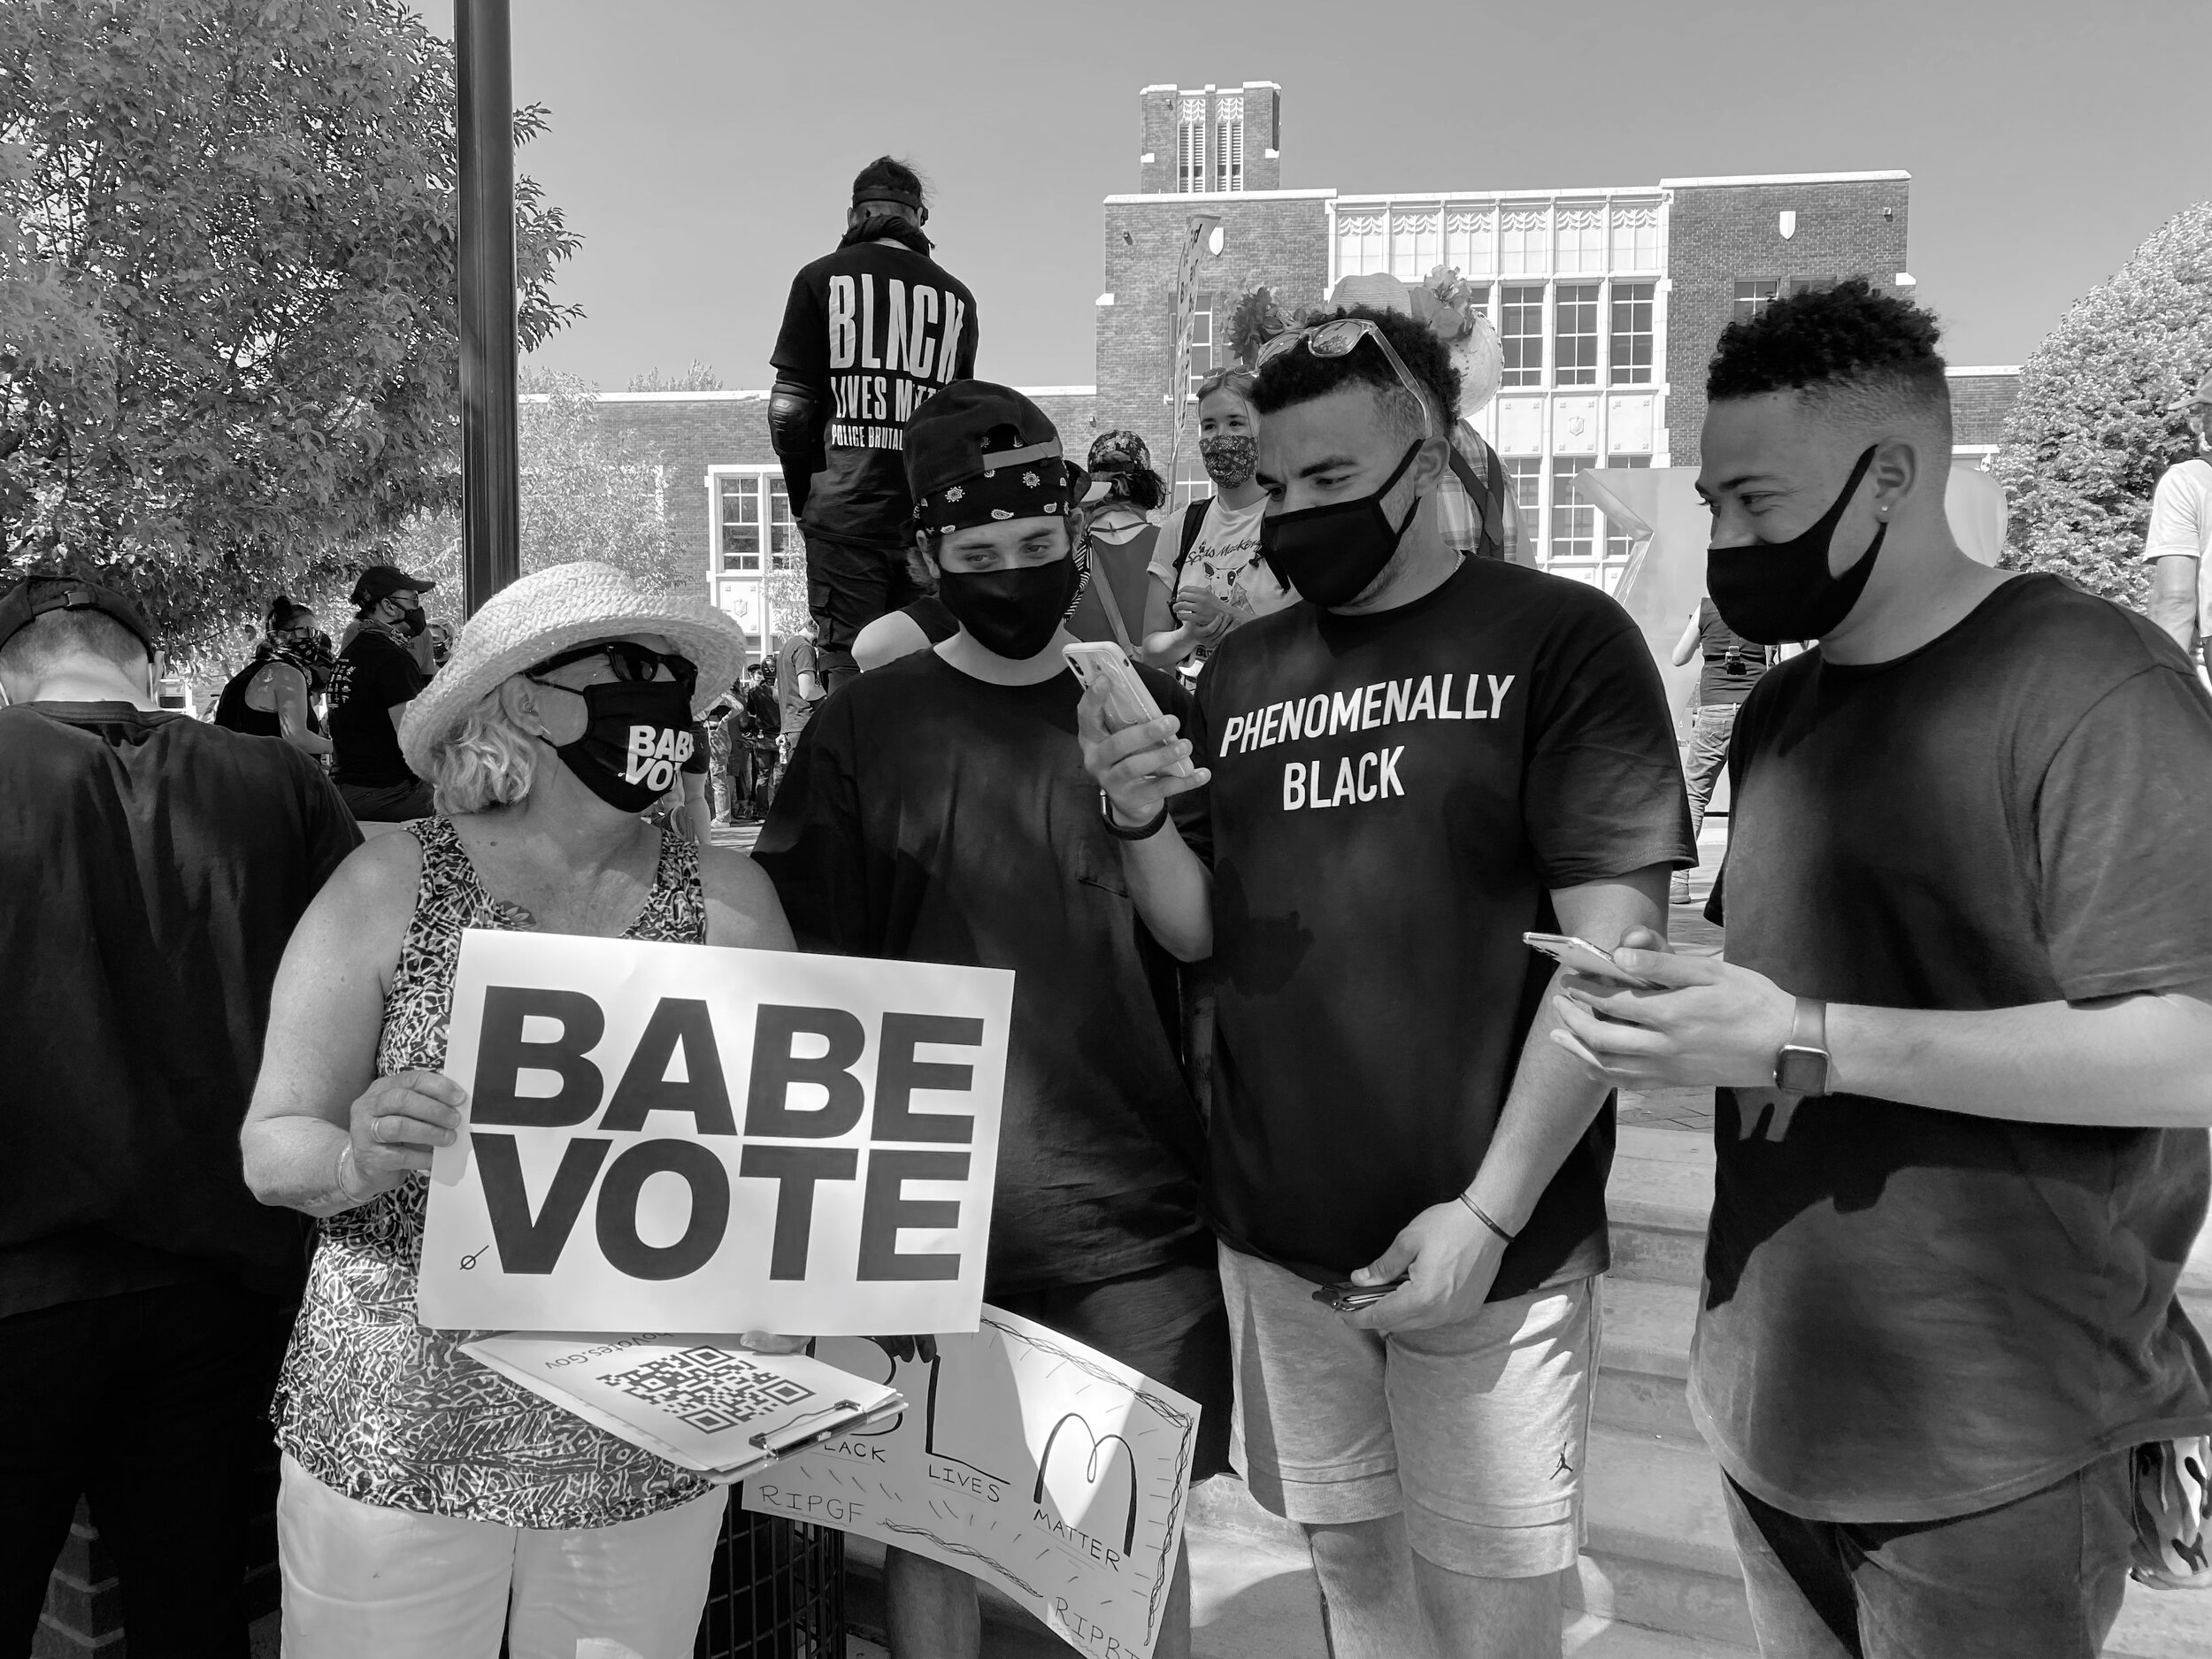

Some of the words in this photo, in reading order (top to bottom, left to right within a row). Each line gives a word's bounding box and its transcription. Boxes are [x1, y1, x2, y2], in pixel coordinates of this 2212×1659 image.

[829, 273, 965, 385] BLACK
[830, 375, 887, 420] LIVES
[895, 379, 940, 422] MATT
[831, 424, 865, 448] POLICE
[1219, 673, 1516, 757] PHENOMENALLY
[1283, 745, 1405, 811] BLACK
[470, 985, 985, 1144] BABE
[470, 1132, 972, 1281] VOTE
[758, 1485, 864, 1523] RIPGF
[928, 1464, 1001, 1502] LIVES
[1033, 1509, 1120, 1572] MATTER
